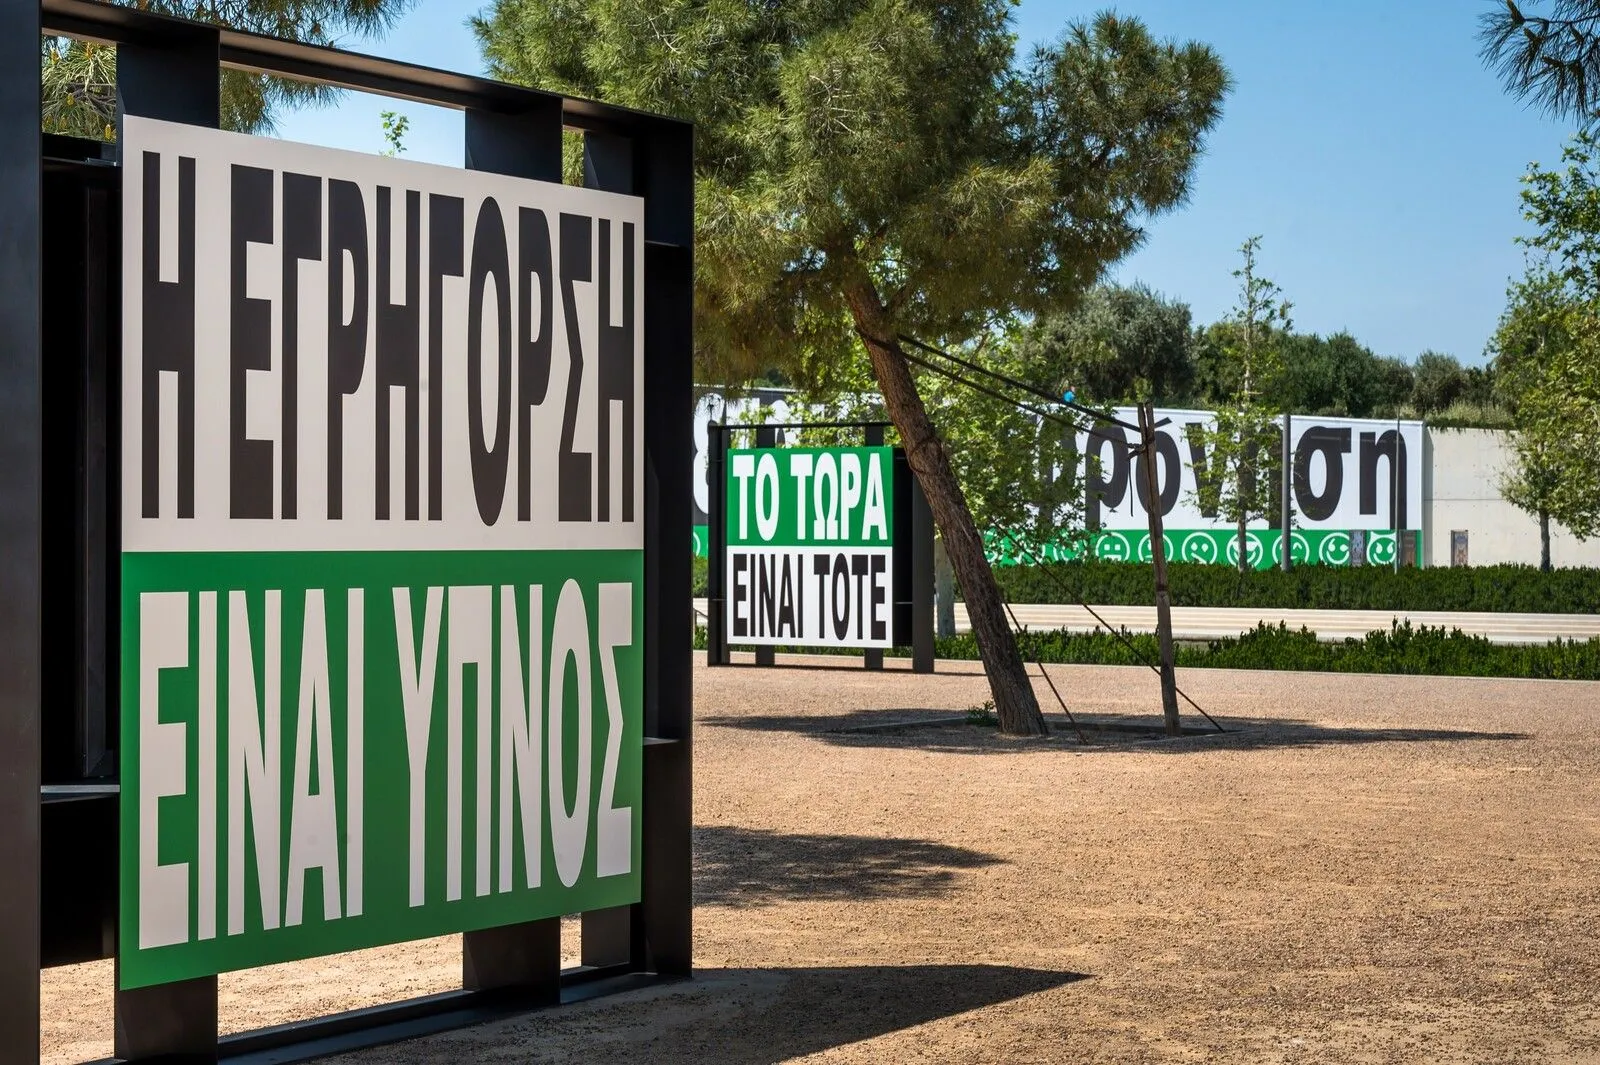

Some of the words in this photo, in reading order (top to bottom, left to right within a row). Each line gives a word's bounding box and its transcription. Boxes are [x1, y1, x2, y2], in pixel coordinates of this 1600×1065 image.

[142, 151, 195, 518] Η
[230, 164, 634, 526] ΕΓΡΗΓΟΡΣΗ
[733, 453, 779, 540] ΤΟ
[791, 453, 887, 539] ΤΩΡΑ
[733, 554, 803, 638] ΕΙΝΑΙ
[814, 553, 886, 640] ΤΟΤΕ
[139, 588, 364, 949] ΕΙΝΑΙ
[393, 579, 632, 907] ΥΠΝΟΣ
